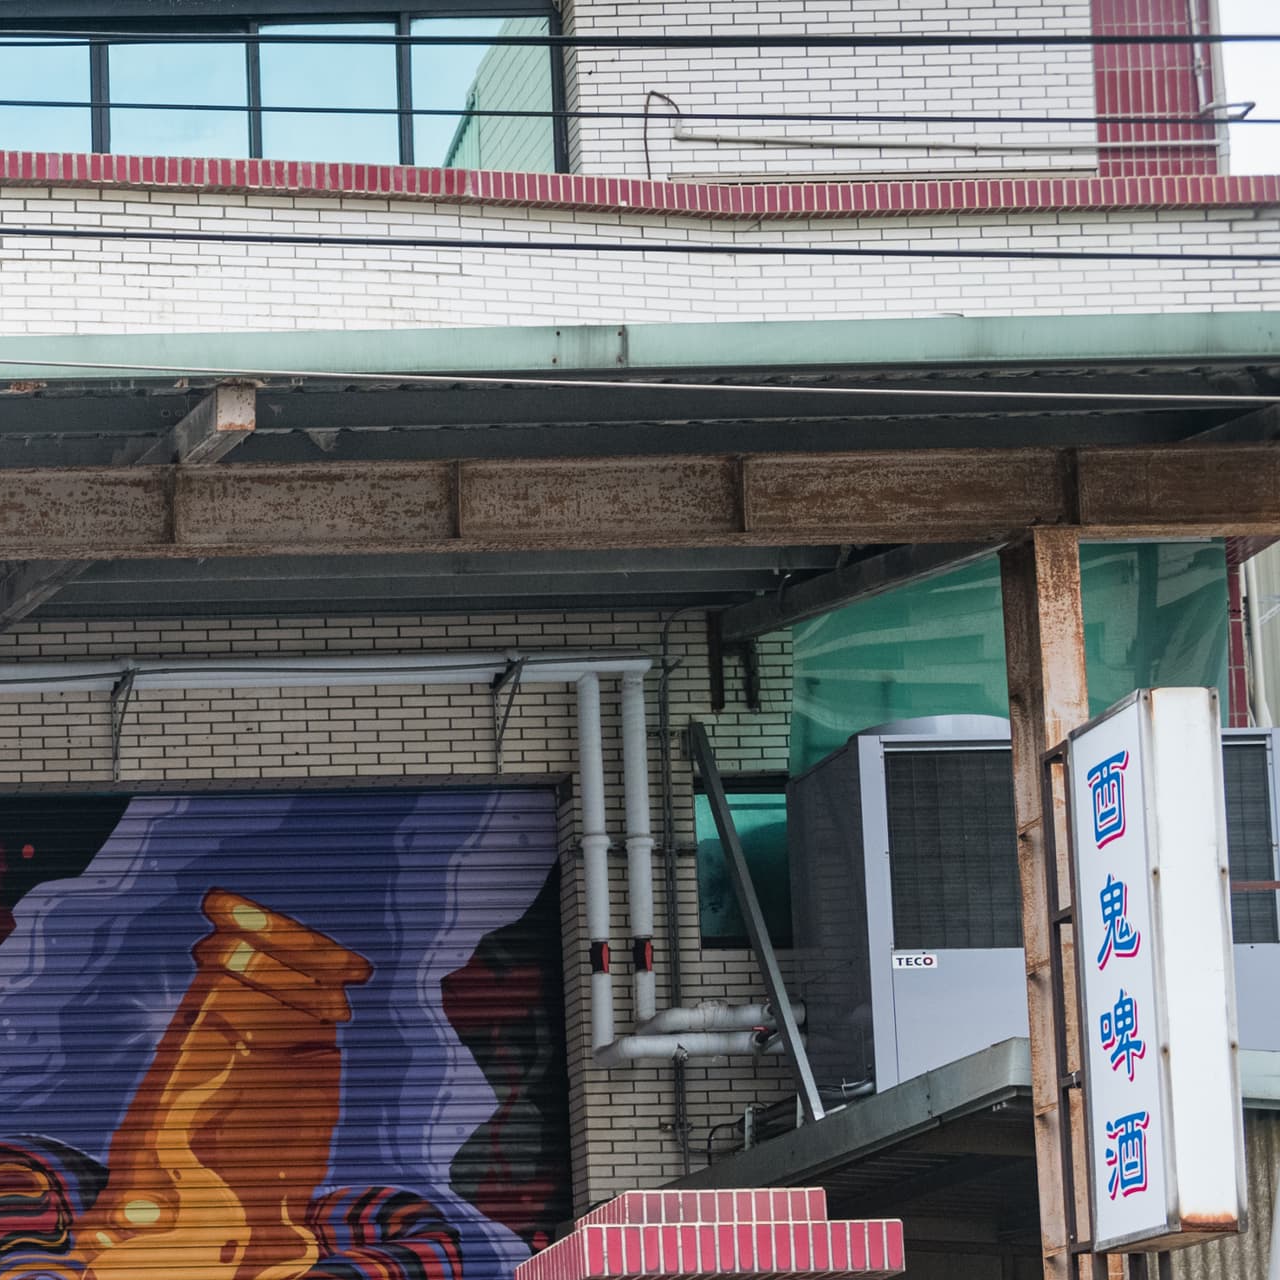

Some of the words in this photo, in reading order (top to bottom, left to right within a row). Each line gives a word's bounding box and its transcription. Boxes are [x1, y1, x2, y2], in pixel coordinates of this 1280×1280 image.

[896, 957, 934, 966] TECO
[1087, 750, 1149, 1200] 酉鬼啤酒
